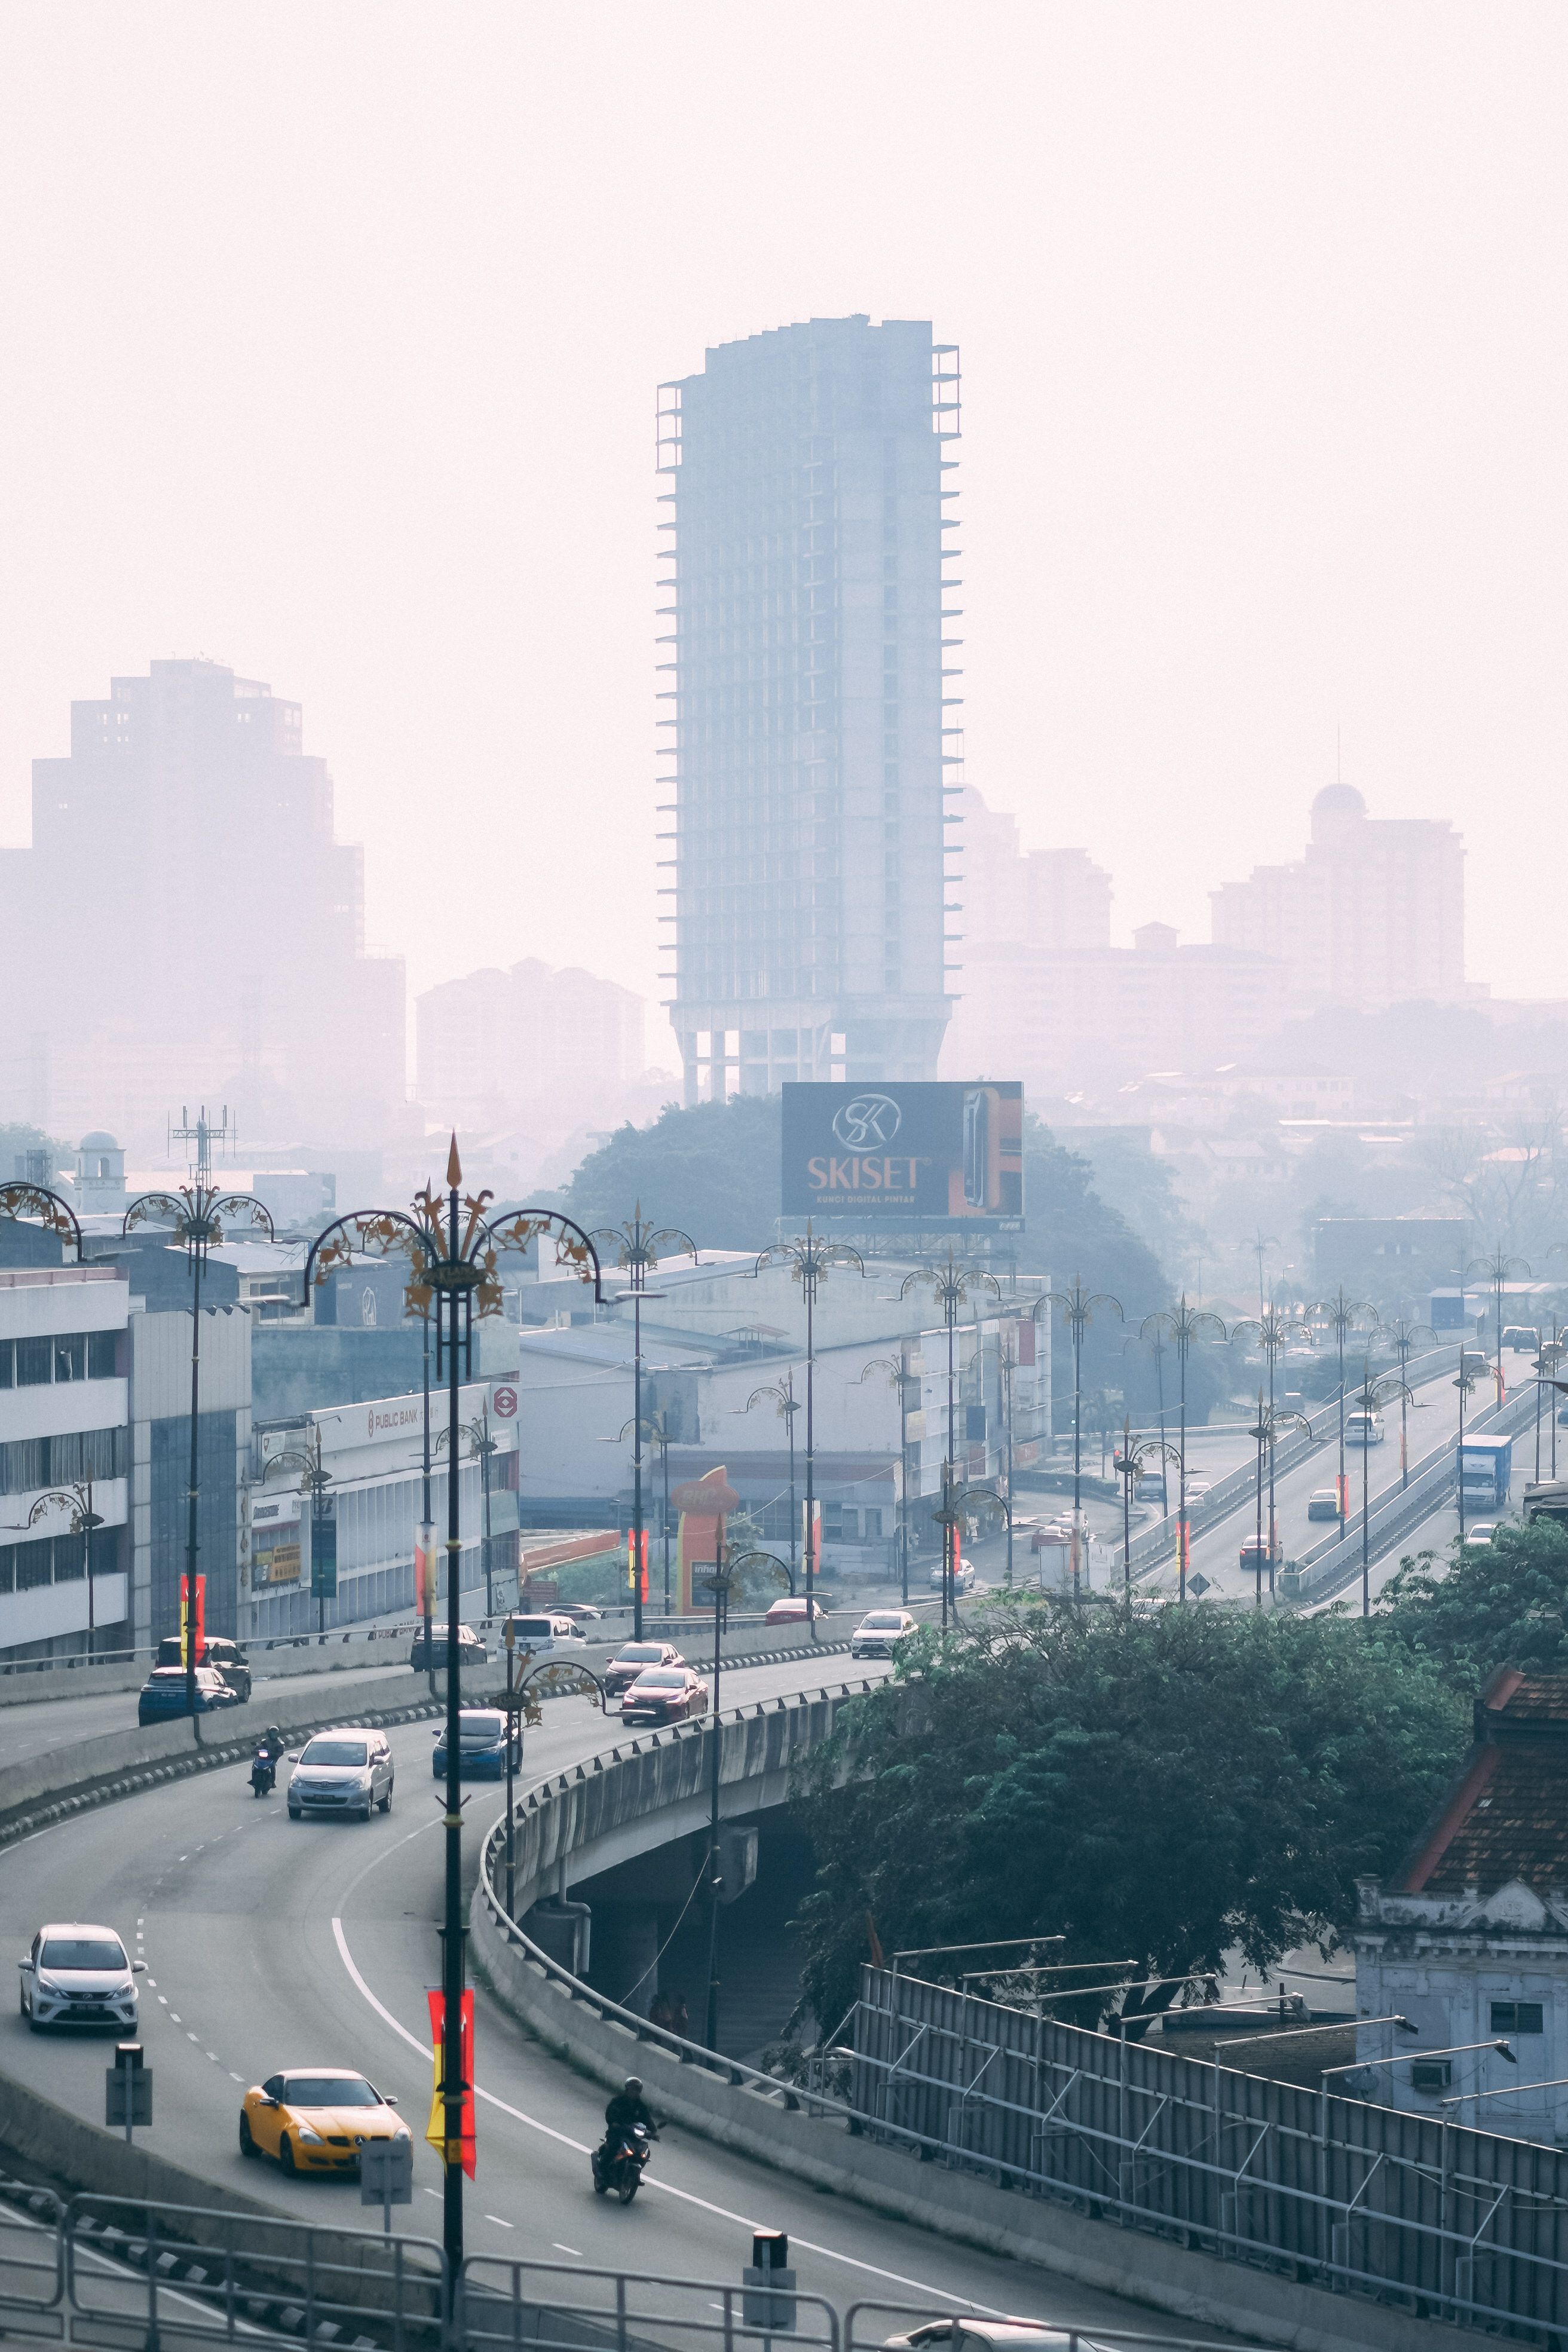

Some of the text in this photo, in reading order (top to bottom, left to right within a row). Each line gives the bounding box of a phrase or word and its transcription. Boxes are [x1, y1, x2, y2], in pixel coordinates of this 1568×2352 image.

[808, 1157, 923, 1189] SKISET
[376, 1408, 418, 1429] PUBLIC BANK
